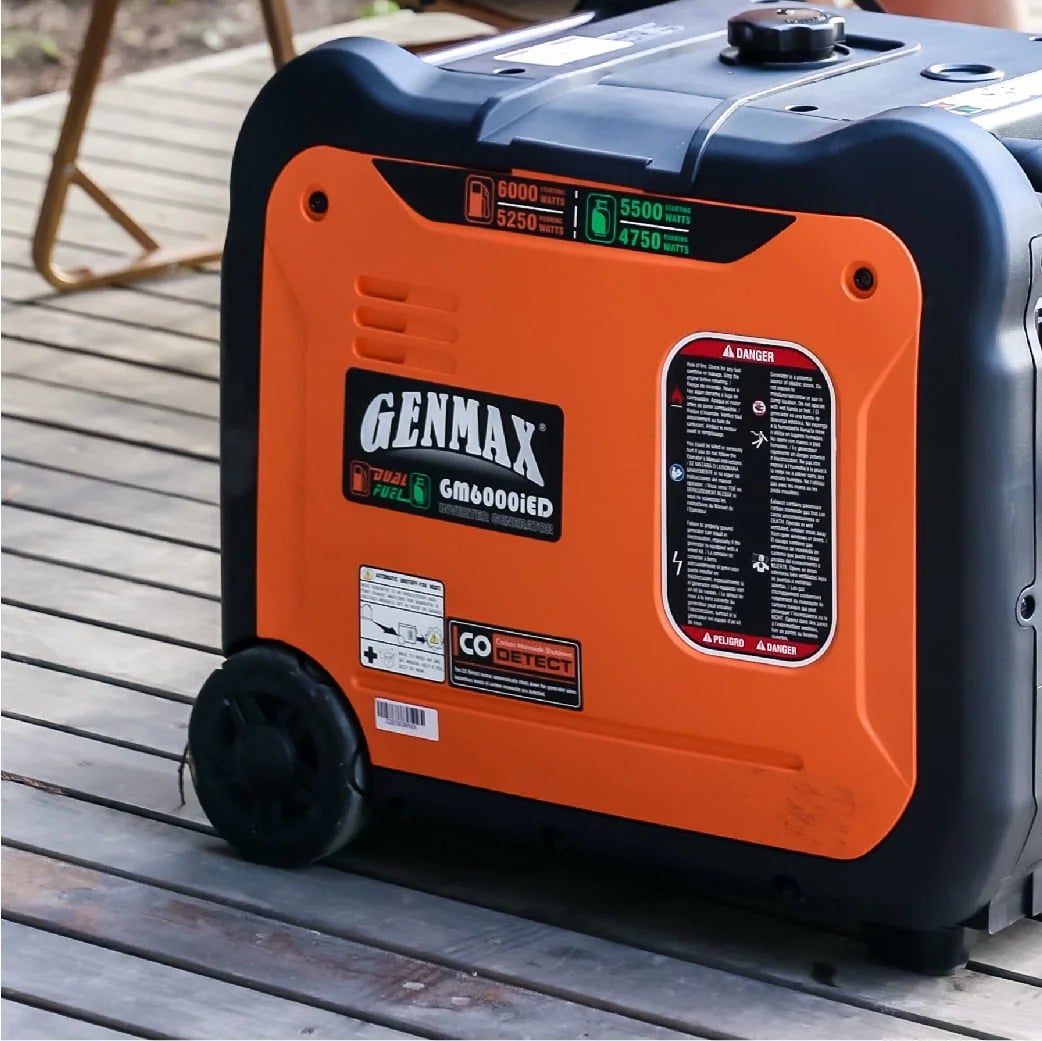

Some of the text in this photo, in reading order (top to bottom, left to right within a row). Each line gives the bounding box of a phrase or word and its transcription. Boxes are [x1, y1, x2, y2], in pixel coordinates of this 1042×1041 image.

[497, 180, 538, 203] 6000
[540, 195, 566, 207] WATTS
[620, 198, 663, 221] 5500
[665, 213, 692, 225] WATTS
[496, 209, 538, 232] 5250
[538, 223, 565, 236] WATTS
[618, 228, 661, 250] 4750
[663, 243, 689, 255] WATTS
[736, 347, 775, 363] DANGER
[360, 391, 545, 488] GENMAX
[371, 467, 408, 487] DUAL
[372, 483, 406, 501] FUEL
[439, 478, 554, 519] GM6000iED
[459, 632, 492, 657] CO
[713, 635, 745, 648] PELIGRO
[766, 643, 797, 656] DANGER
[496, 647, 573, 673] DETECT
